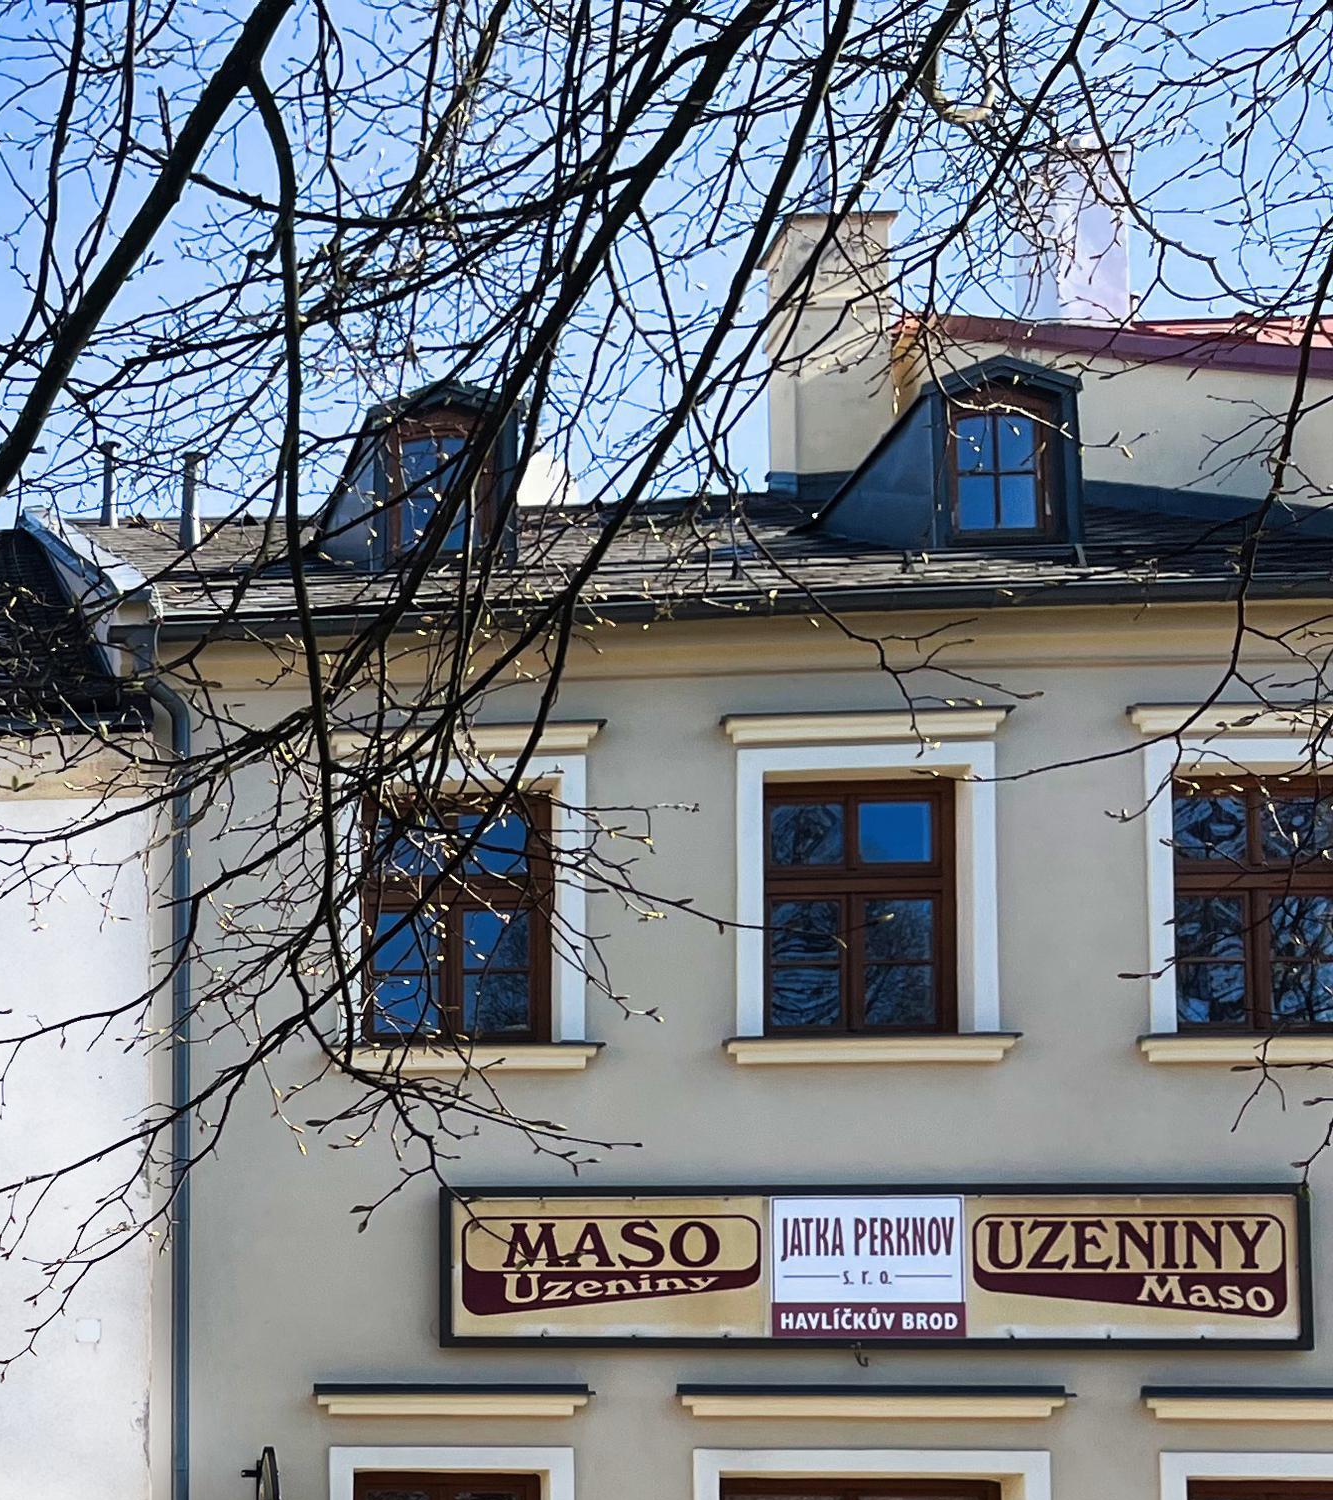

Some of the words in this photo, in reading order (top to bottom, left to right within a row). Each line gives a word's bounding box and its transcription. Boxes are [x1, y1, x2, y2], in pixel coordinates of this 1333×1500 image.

[501, 1219, 721, 1270] MASO
[780, 1216, 845, 1262] JATKA
[853, 1216, 955, 1257] PERKNOV
[985, 1218, 1272, 1271] UZENINY
[502, 1273, 721, 1304] Uzeniny
[1136, 1275, 1276, 1313] Maso
[780, 1306, 896, 1331] HAVLÍČKŮV
[901, 1312, 959, 1331] BROD
